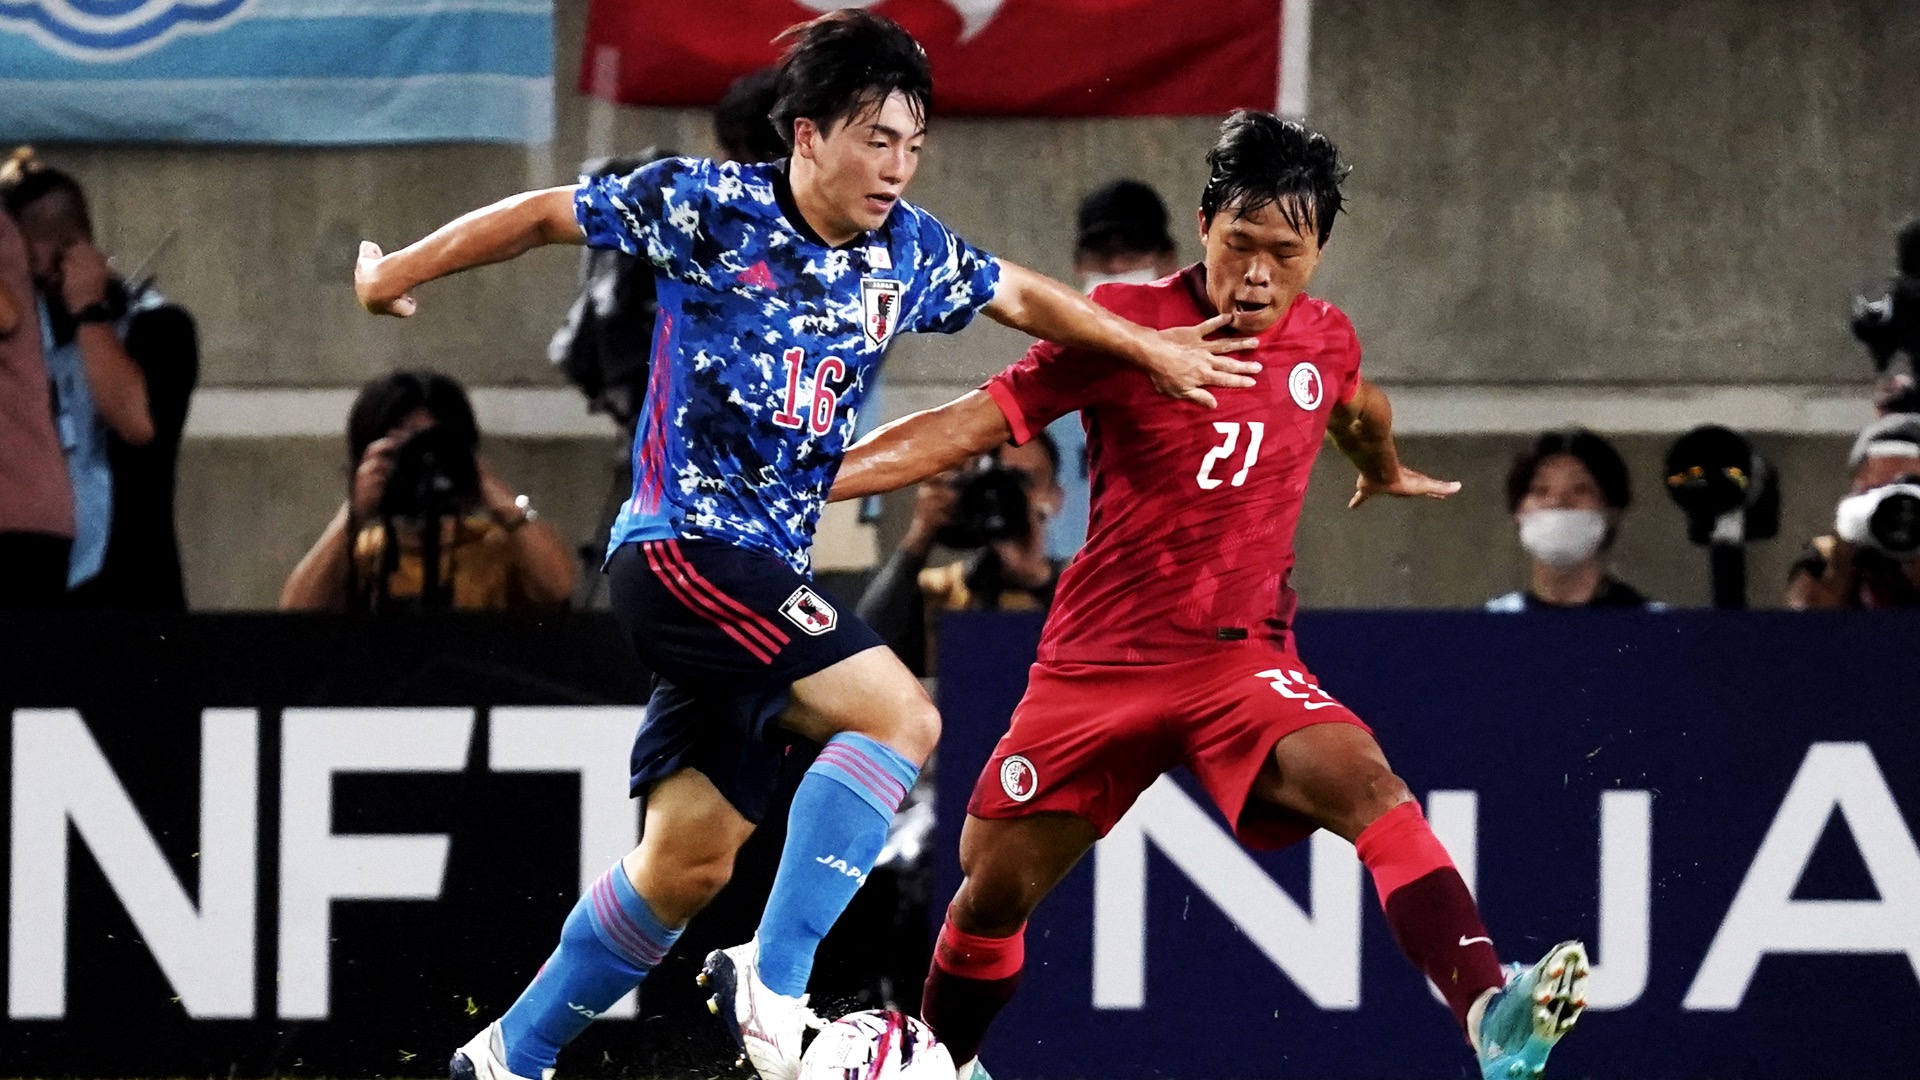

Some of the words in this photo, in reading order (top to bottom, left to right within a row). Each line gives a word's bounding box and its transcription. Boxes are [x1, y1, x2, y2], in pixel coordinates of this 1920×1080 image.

[872, 281, 894, 290] JAPAN
[772, 347, 845, 436] 16
[1196, 422, 1264, 489] 21
[9, 706, 651, 1019] NFT
